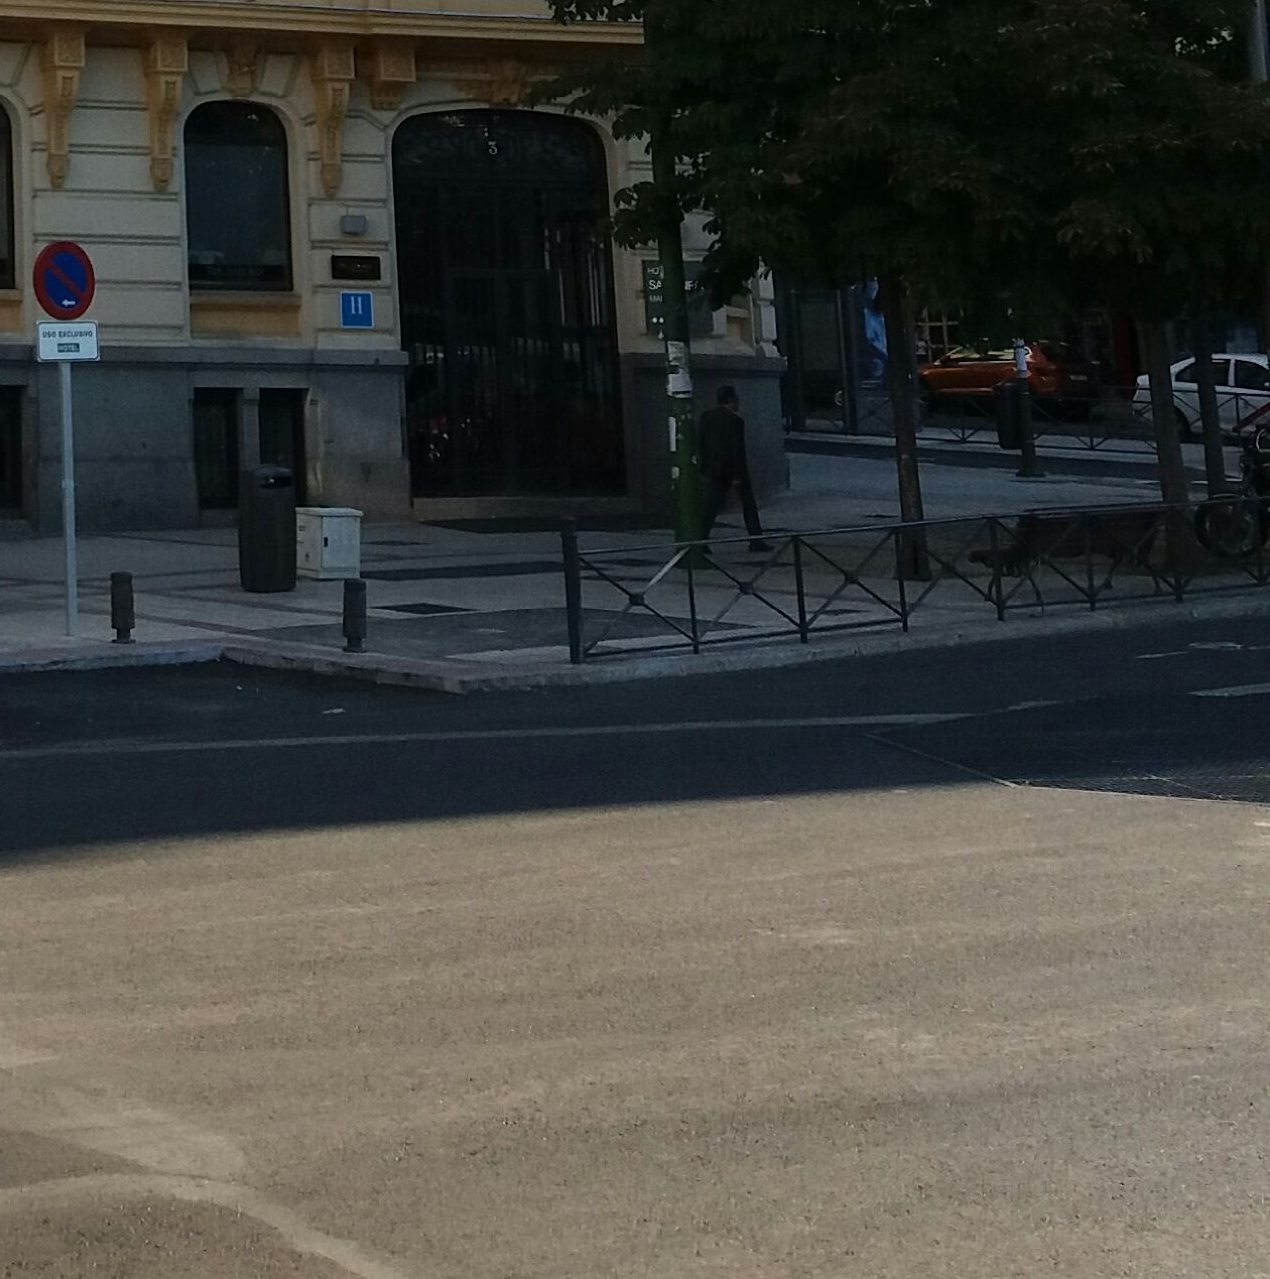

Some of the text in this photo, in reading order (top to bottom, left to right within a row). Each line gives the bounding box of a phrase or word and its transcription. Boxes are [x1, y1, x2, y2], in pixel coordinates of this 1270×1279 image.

[350, 296, 363, 315] H
[42, 330, 93, 338] USO EXCLUSIVO
